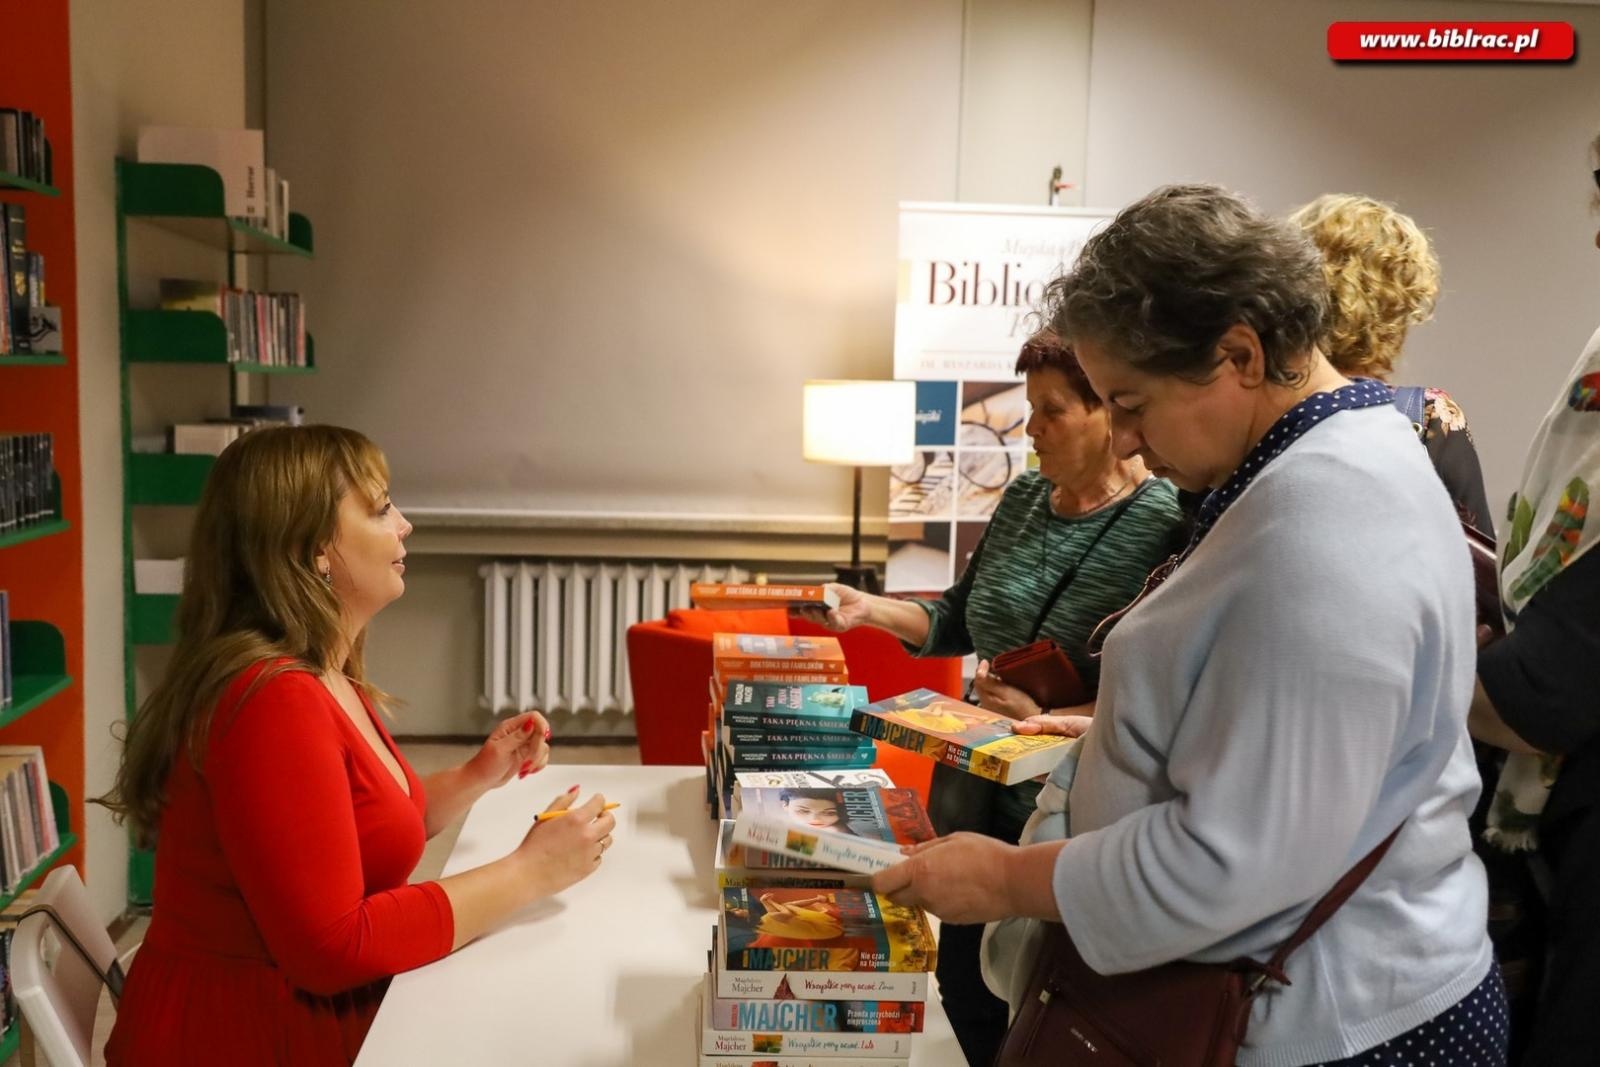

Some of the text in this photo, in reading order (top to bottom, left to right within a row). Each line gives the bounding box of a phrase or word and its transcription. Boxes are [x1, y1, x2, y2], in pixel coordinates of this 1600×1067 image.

[762, 717, 785, 725] TAKA
[786, 718, 817, 728] PIĘKNA
[767, 734, 789, 742] TAKA
[789, 734, 821, 743] PIĘKNA
[865, 715, 926, 753] MAJCHER
[771, 753, 793, 761] TAKA
[794, 752, 825, 762] PIĘKNA
[956, 748, 968, 758] czas
[750, 948, 830, 970] MAJCHER
[860, 951, 885, 962] Nie czas
[859, 960, 867, 968] na
[731, 983, 764, 995] Majcher
[738, 1001, 838, 1032] MAJCHER
[847, 1009, 869, 1019] Prawda
[869, 1009, 901, 1020] przychodzi
[846, 1017, 882, 1027] nieproszona
[715, 1040, 747, 1052] Majcher
